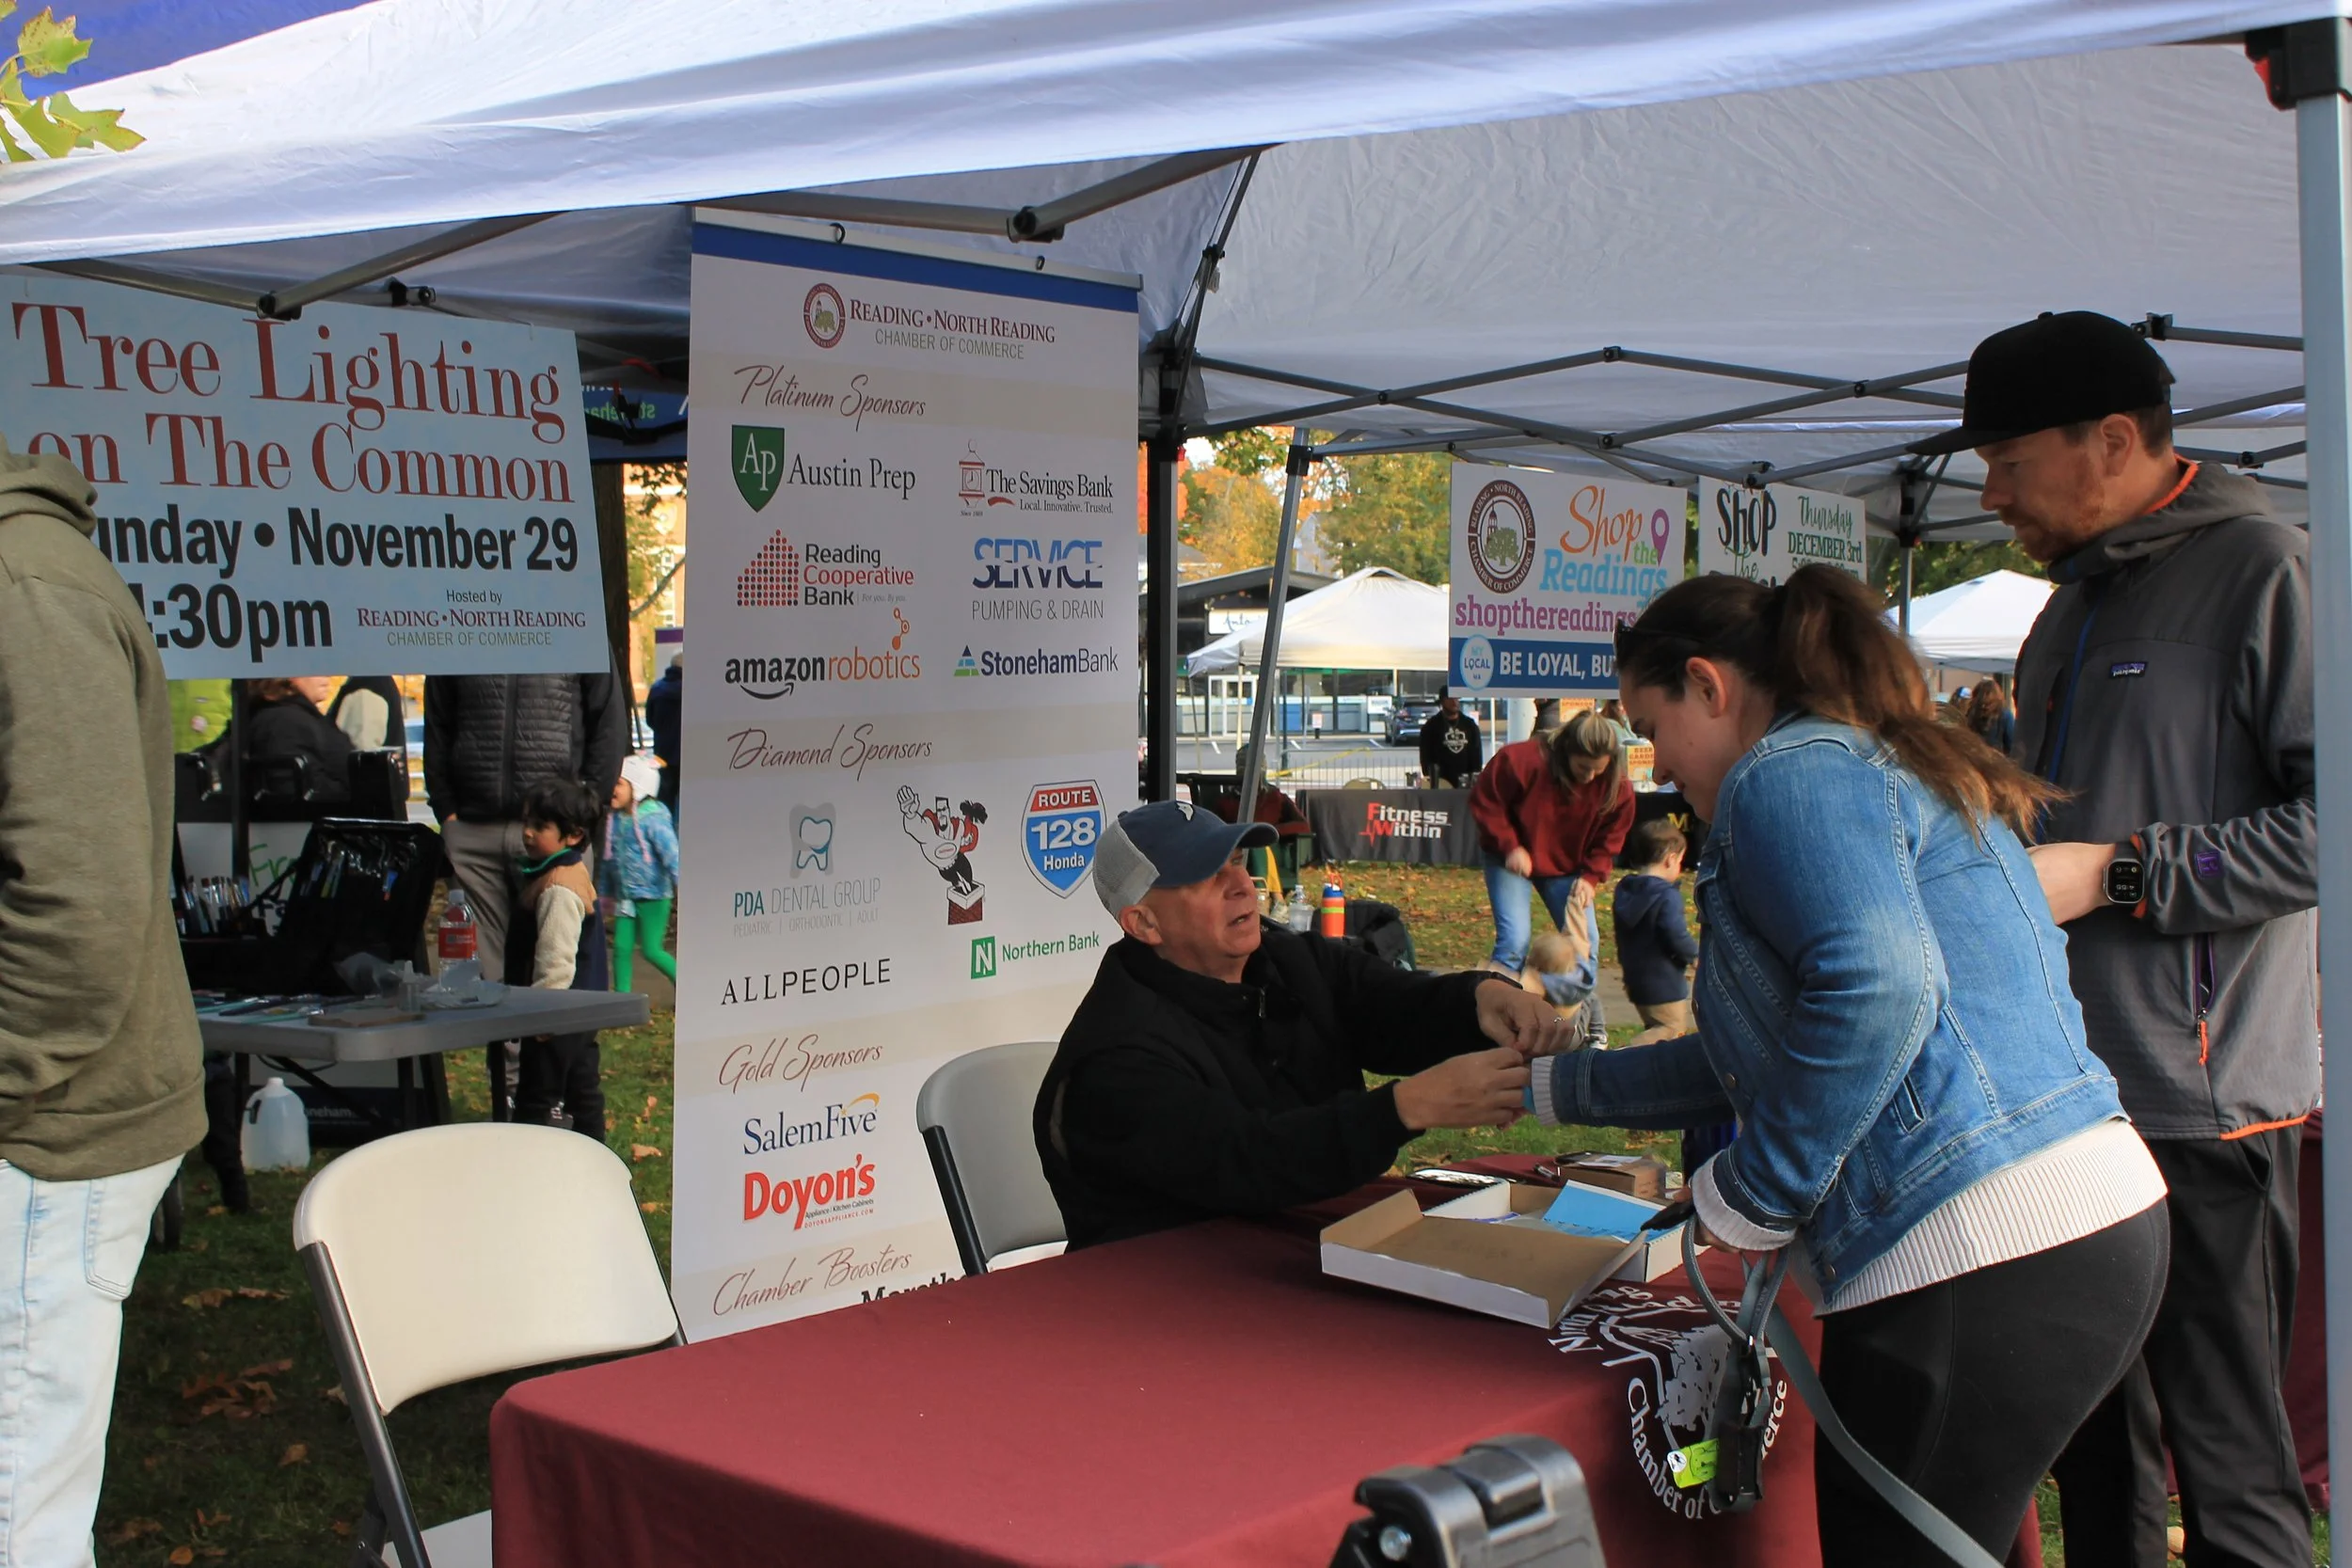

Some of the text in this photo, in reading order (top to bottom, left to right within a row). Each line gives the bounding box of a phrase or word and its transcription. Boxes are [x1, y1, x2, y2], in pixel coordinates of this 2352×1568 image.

[850, 299, 924, 326] READING
[934, 309, 987, 335] NORTH
[991, 316, 1056, 343] READING
[876, 328, 1025, 359] CHAMBER OF COMMERCE
[11, 302, 565, 444] Tree Lighting
[734, 365, 927, 432] Platinum Sponsors
[145, 413, 291, 489] The
[311, 422, 575, 502] Common
[787, 453, 916, 500] Austin Prep
[986, 469, 1113, 500] The Savings Bank
[1493, 483, 1517, 498] NORTH
[1020, 499, 1041, 512] Local.
[1043, 500, 1083, 514] Innovative.
[1798, 496, 1852, 539] Thursday
[1560, 485, 1643, 562] Shop
[96, 503, 579, 578] unday November 29
[805, 543, 881, 569] Reading
[1633, 542, 1659, 564] the
[1788, 531, 1862, 563] DECEMBER 3rd
[803, 564, 914, 588] Cooperative
[973, 537, 1103, 589] SERVICE
[1539, 548, 1667, 610] Readings
[447, 590, 502, 605] Hosted by
[804, 586, 854, 606] Bank
[973, 599, 1104, 621] PUMPING & DRAIN
[357, 609, 586, 628] READING NORTH READING
[388, 632, 551, 646] CHAMBER OF COMMERCE
[1464, 658, 1490, 671] LOCAL
[1500, 652, 1522, 675] BE
[1528, 652, 1585, 680] LOYAL,
[727, 723, 932, 782] Diamond Sponsors
[1038, 789, 1091, 808] ROUTE
[1367, 802, 1449, 824] Fitness
[1031, 816, 1096, 850] 128
[1374, 820, 1441, 840] Within
[1043, 852, 1086, 872] Honda
[734, 878, 881, 918] PDA DENTAL GROUP
[1002, 931, 1100, 962] Northern Bank
[719, 1034, 883, 1095] Gold Sponsors
[744, 1153, 875, 1231] Doyon's
[713, 1258, 813, 1316] Chamber
[818, 1244, 912, 1290] Boosters
[1628, 1377, 1683, 1513] Chamber
[1685, 1486, 1707, 1520] of
